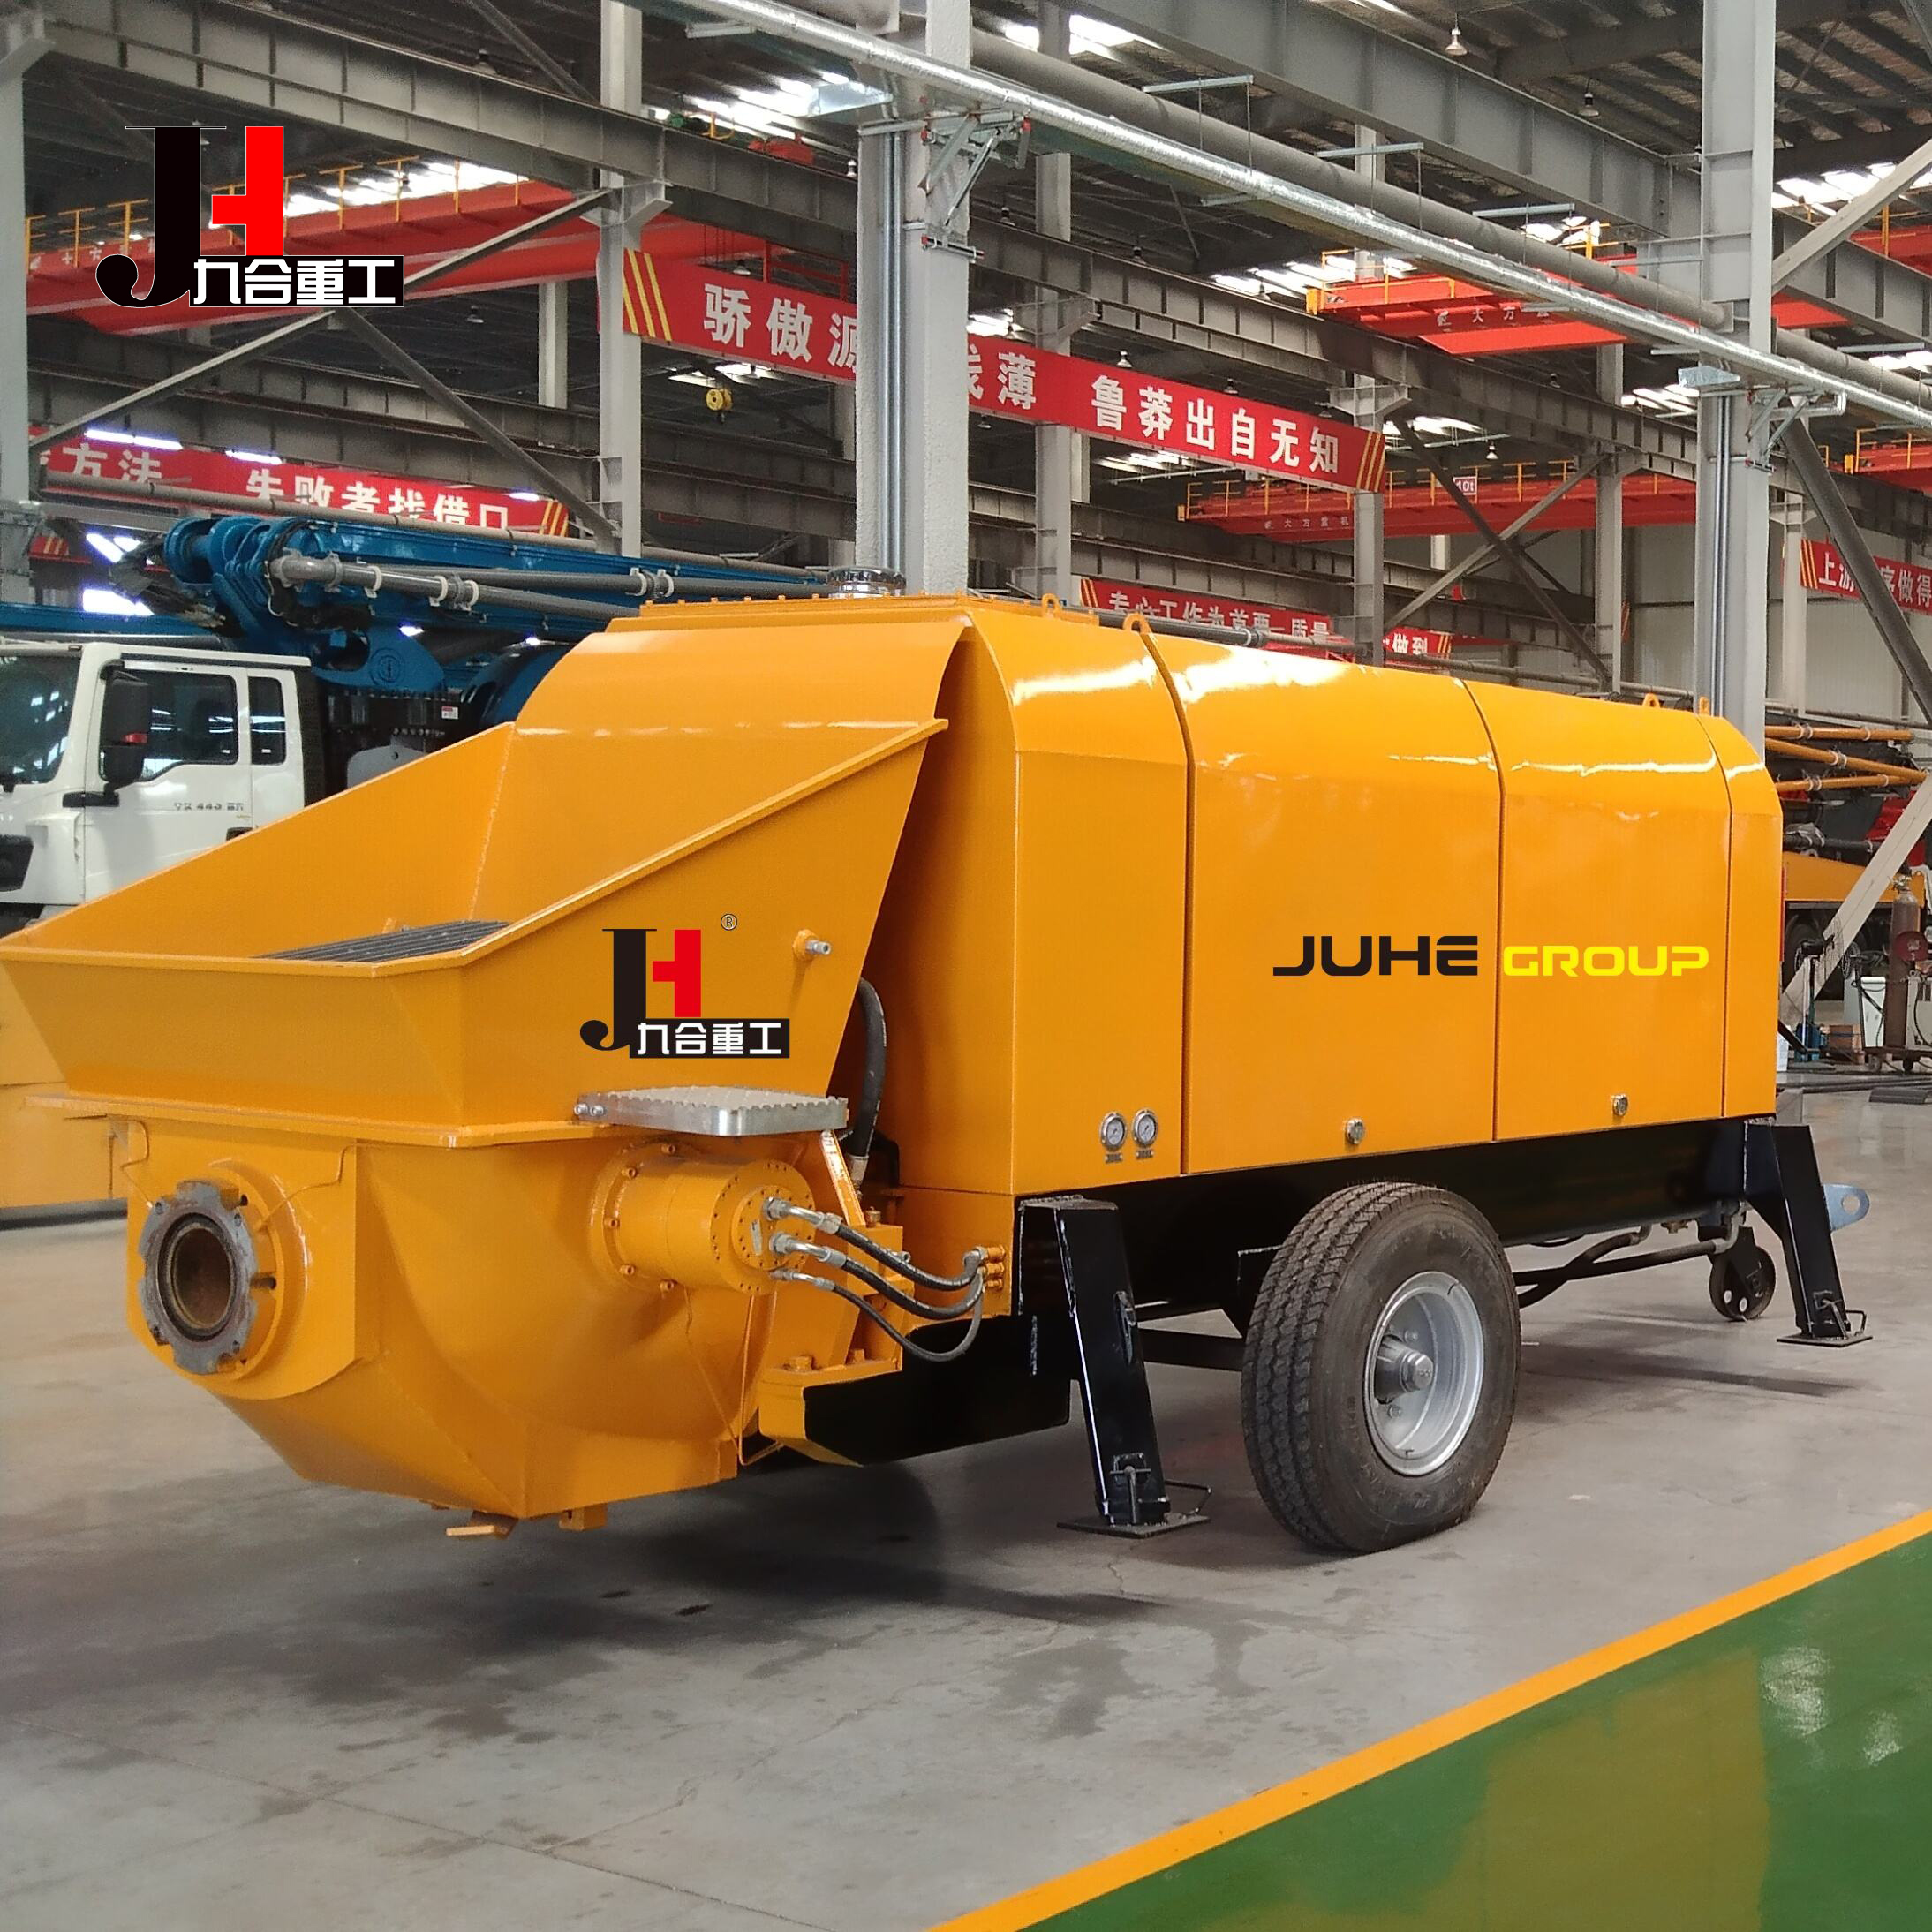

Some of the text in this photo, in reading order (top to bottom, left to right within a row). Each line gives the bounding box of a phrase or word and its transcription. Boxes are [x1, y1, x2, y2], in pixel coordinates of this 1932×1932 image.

[1091, 374, 1339, 474] 鲁莽出自无知
[1272, 935, 1709, 977] JUHE GROUP
[638, 1022, 781, 1055] 九合重工
